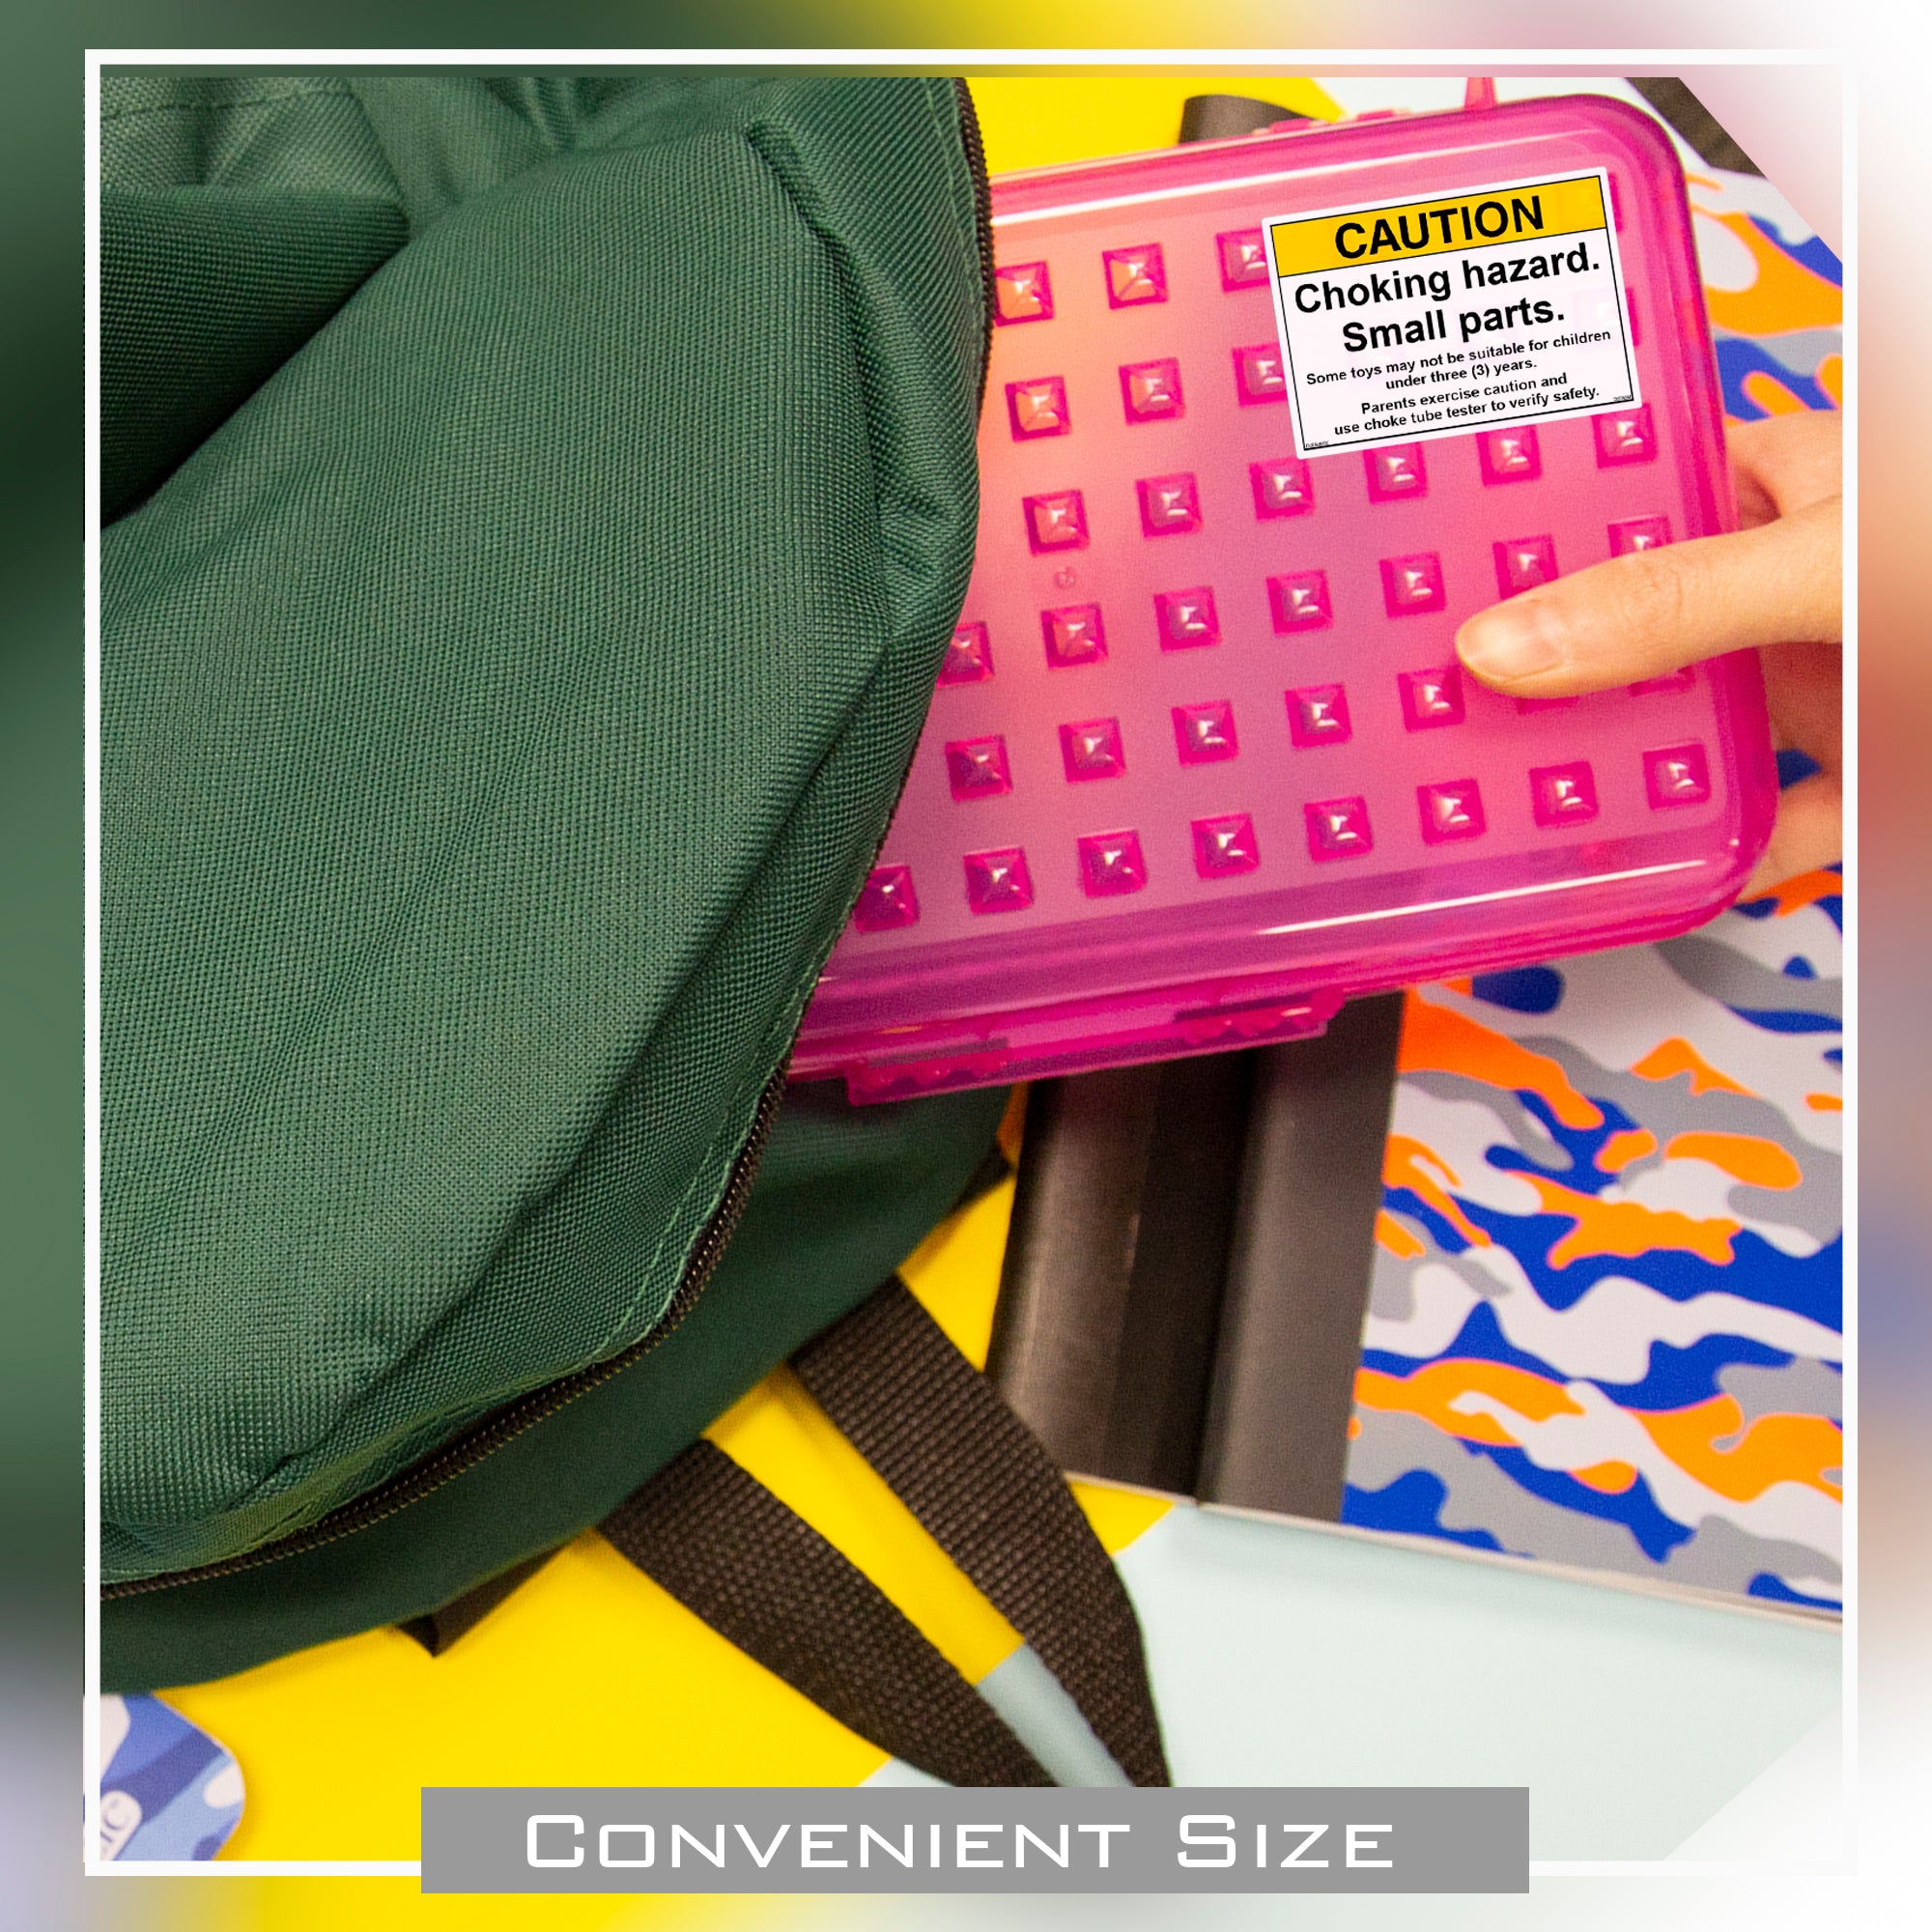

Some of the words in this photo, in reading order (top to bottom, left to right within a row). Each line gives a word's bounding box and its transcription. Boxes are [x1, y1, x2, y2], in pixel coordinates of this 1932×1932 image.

[1334, 195, 1545, 260] CAUTION
[1294, 270, 1452, 314] Choking
[1462, 242, 1601, 290] hazard.
[1342, 308, 1447, 353] Small
[1459, 297, 1565, 343] parts.
[1306, 371, 1348, 385] Some
[1350, 366, 1382, 380] toys
[1385, 361, 1415, 374] may
[1419, 354, 1444, 368] not
[1446, 352, 1465, 364] be
[1468, 342, 1525, 361] suitable
[1528, 339, 1549, 352] for
[1552, 330, 1611, 348] children
[1385, 374, 1427, 390] under
[1430, 369, 1467, 384] three
[1471, 362, 1491, 381] (3)
[1493, 359, 1538, 377] years.
[1334, 423, 1360, 436] use
[1364, 414, 1407, 431] choke
[1410, 410, 1442, 424] tube
[1446, 404, 1487, 418] tester
[1491, 400, 1506, 412] to
[1509, 391, 1549, 409] verify
[1552, 386, 1601, 402] safety.
[1361, 397, 1417, 414] Parents
[1419, 388, 1480, 406] exercise
[1484, 381, 1537, 396] caution
[1541, 372, 1568, 387] and
